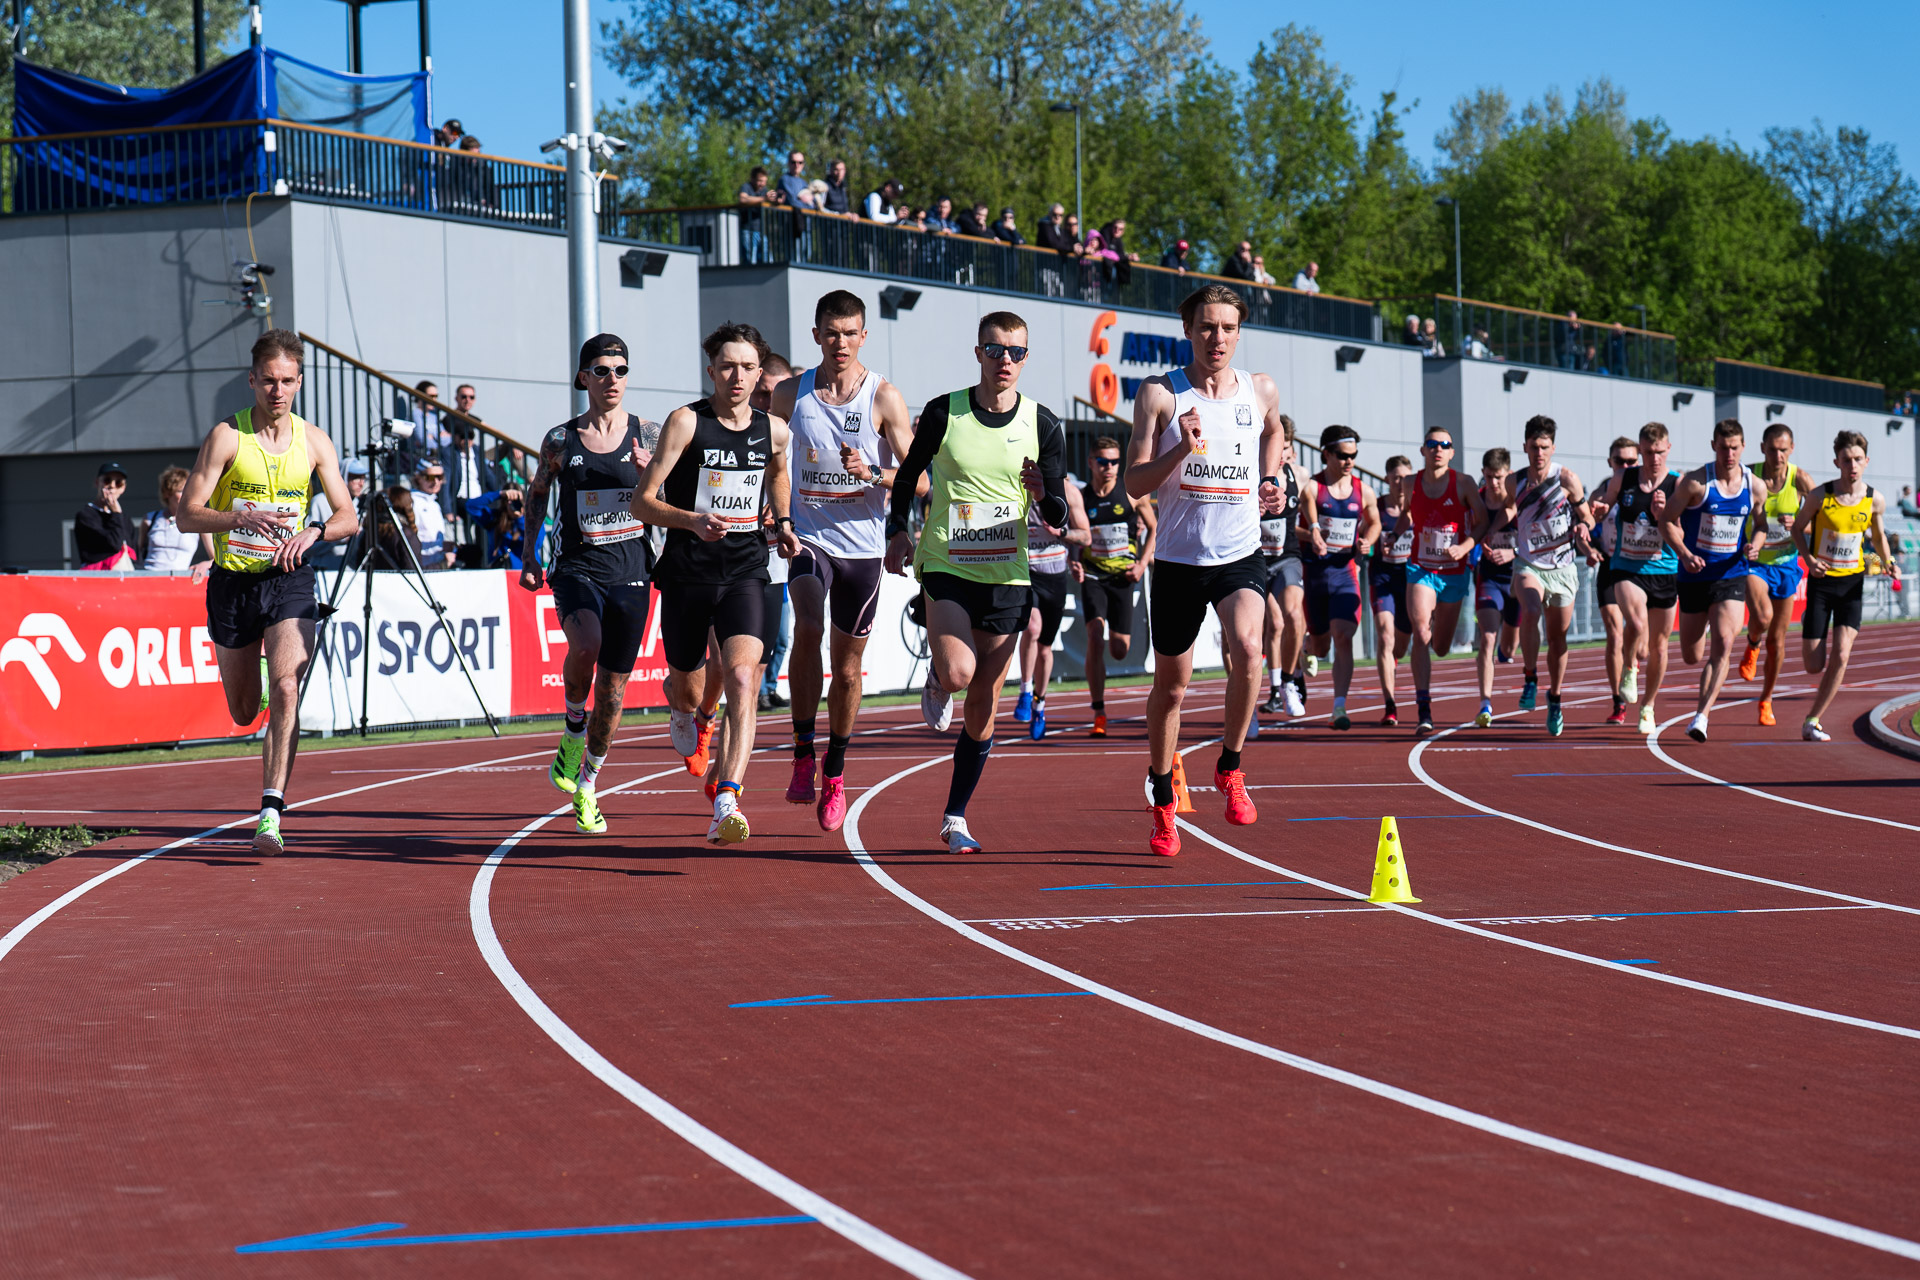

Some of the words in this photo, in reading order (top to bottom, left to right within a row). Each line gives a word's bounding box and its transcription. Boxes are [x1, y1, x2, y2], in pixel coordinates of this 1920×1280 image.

[1234, 442, 1242, 456] 1
[1184, 462, 1250, 481] ADAMCZAK
[743, 474, 758, 487] 40
[617, 491, 633, 503] 28
[803, 496, 840, 504] WARSZAWA
[1188, 491, 1228, 501] WARSZAWA
[710, 495, 753, 510] KIJAK
[993, 506, 1010, 518] 24
[580, 511, 636, 526] MACHOWS
[1550, 519, 1562, 529] 74
[1269, 521, 1281, 530] 89
[623, 531, 637, 540] 2025
[952, 526, 1016, 542] KROCHMAL
[235, 548, 273, 558] WARSZAWA
[1826, 545, 1855, 557] MIREK
[957, 555, 996, 563] WARSZAWA
[996, 554, 1011, 562] 2025
[377, 615, 501, 677] SPORT
[98, 625, 223, 689] ORLE
